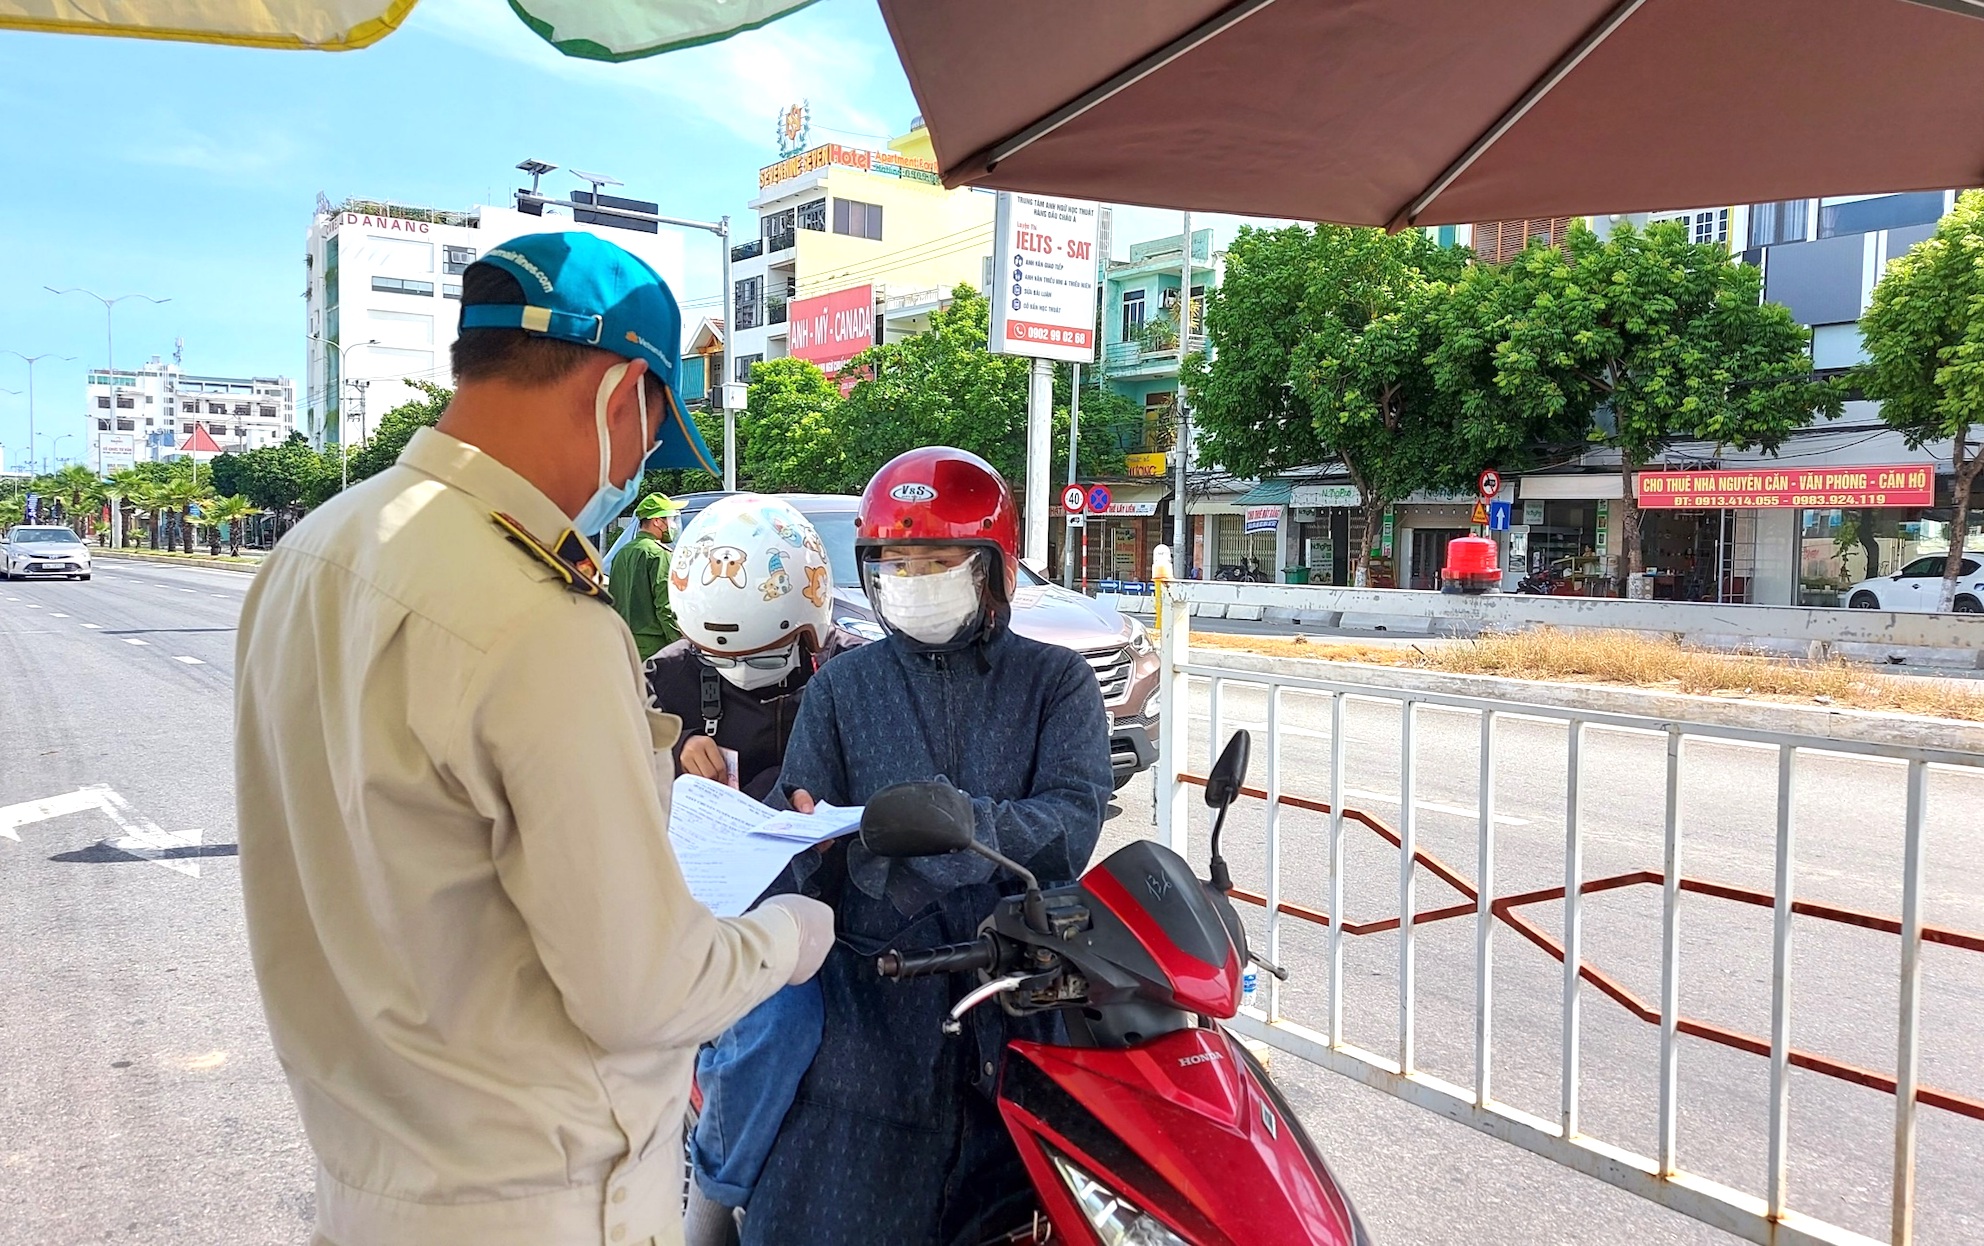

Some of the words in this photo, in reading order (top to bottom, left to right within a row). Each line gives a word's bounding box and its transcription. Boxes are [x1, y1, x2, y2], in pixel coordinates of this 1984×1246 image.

[831, 144, 870, 170] Hotel
[1017, 195, 1033, 206] TRUNG
[1045, 202, 1056, 211] ANH
[347, 212, 430, 234] DANANG
[1016, 230, 1053, 255] IELTS
[1067, 239, 1092, 260] SAT
[790, 319, 809, 350] ANH
[814, 306, 829, 346] MỸ
[834, 305, 872, 343] CANADA
[1028, 326, 1049, 340] 0902
[1050, 329, 1061, 341] 99
[1062, 331, 1074, 343] 02
[1074, 333, 1086, 344] 68
[1643, 478, 1663, 492] CHO
[1666, 475, 1691, 492] THUÊ
[1694, 474, 1716, 491] NHÀ
[1719, 473, 1762, 491] NGUYÊN
[1764, 472, 1789, 491] CĂN
[1799, 472, 1822, 491] VĂN
[1825, 470, 1867, 490] PHÒNG
[1879, 470, 1905, 489] CĂN
[1908, 469, 1926, 492] HỘ
[902, 485, 926, 496] V&S
[1068, 491, 1080, 505] 40
[1674, 496, 1692, 506] ĐT:
[1694, 495, 1779, 506] 0913.414.055
[1792, 494, 1886, 505] 0983.924.119
[1178, 1051, 1224, 1067] HONDA
